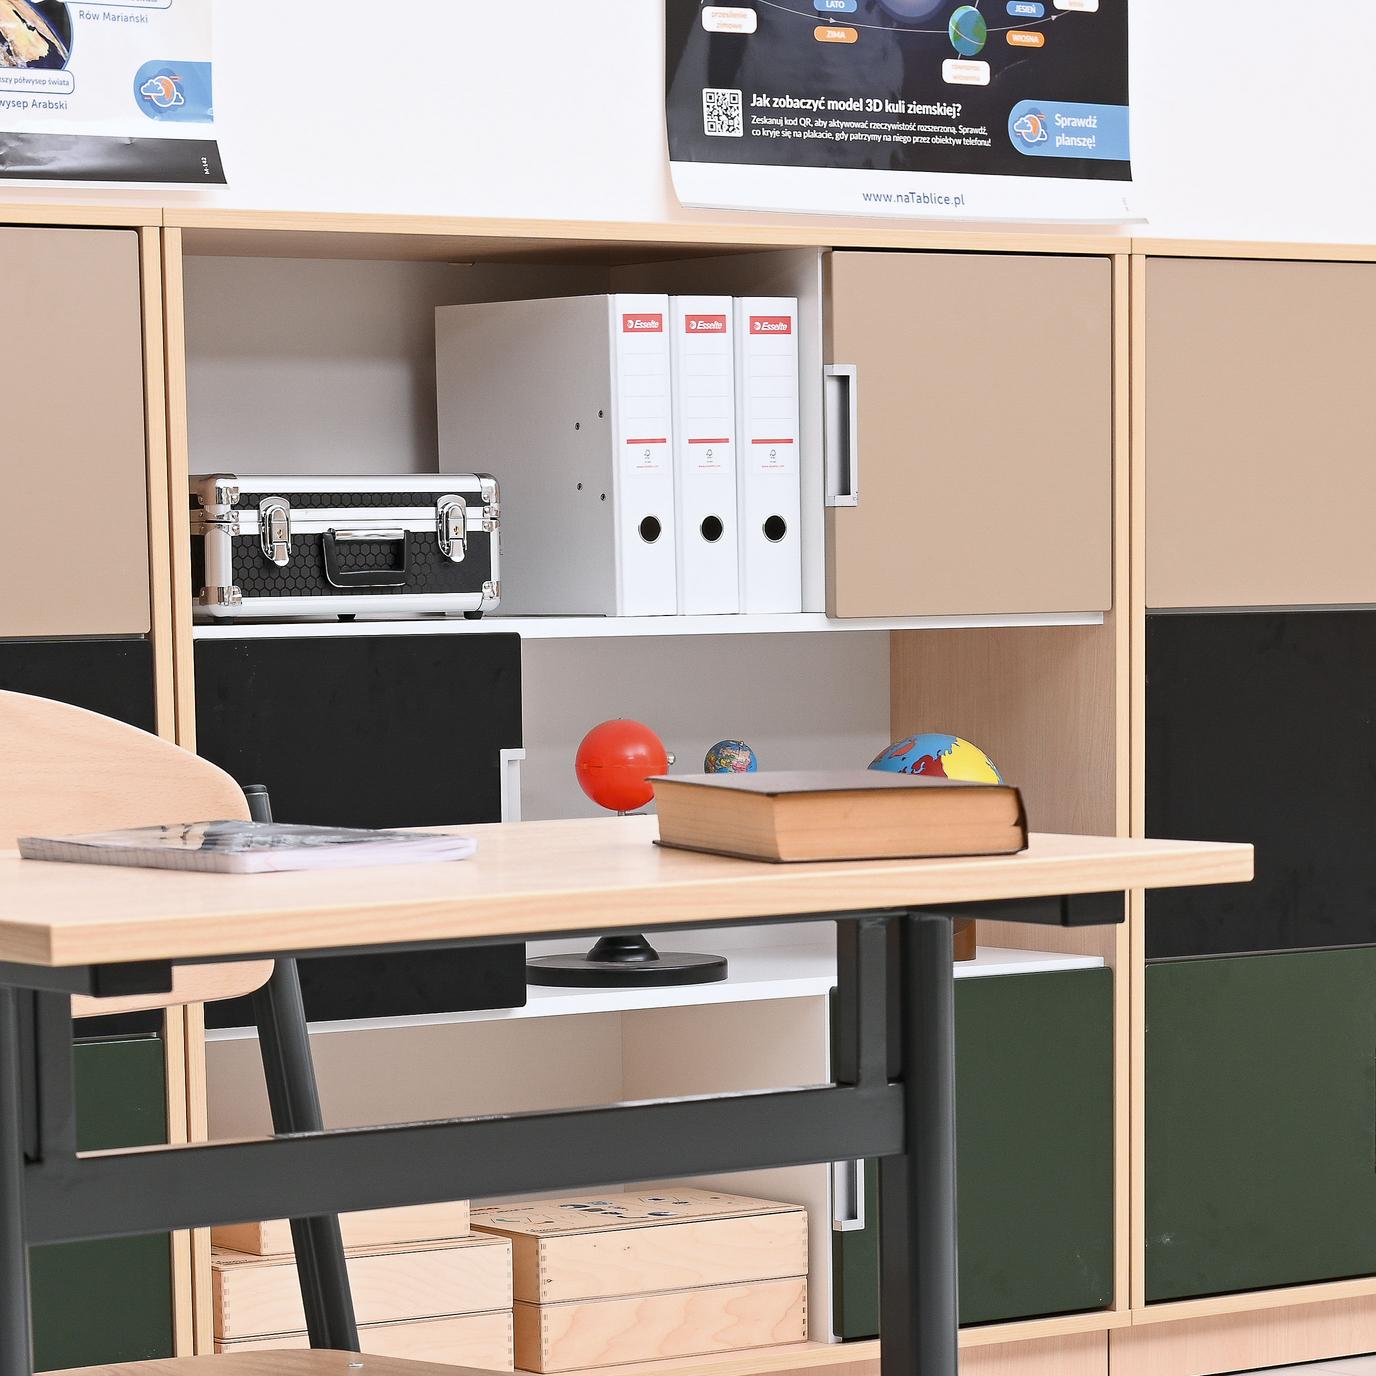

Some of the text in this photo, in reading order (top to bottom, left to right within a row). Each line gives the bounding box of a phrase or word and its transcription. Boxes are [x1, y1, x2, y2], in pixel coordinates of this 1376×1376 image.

[79, 10, 148, 23] Rów Mariański
[826, 30, 846, 39] ZIMA
[14, 76, 46, 86] półwysep
[48, 78, 70, 87] świata
[31, 98, 68, 110] Arabski
[750, 94, 962, 118] Jak zobaczyć model 3D kuli ziemskiej?
[751, 115, 783, 127] Zeskanuj
[784, 117, 798, 126] kod
[799, 118, 813, 128] QR,
[814, 119, 827, 129] aby
[828, 119, 869, 130] aktywować
[870, 120, 916, 131] rzeczywistość
[1055, 113, 1097, 129] Sprawdź
[762, 128, 780, 138] kryje
[781, 129, 792, 139] się
[803, 130, 834, 140] plakacie,
[835, 131, 849, 141] gdy
[850, 132, 881, 142] patrzymy
[883, 134, 891, 142] na
[892, 134, 911, 144] niego
[912, 135, 930, 145] przez
[931, 135, 962, 146] obiektyw
[1055, 134, 1096, 148] planszę!
[862, 192, 965, 208] www.naTablice.pl
[634, 320, 659, 329] Esselte
[696, 320, 722, 330] Esselte
[761, 321, 788, 331] Esselte
